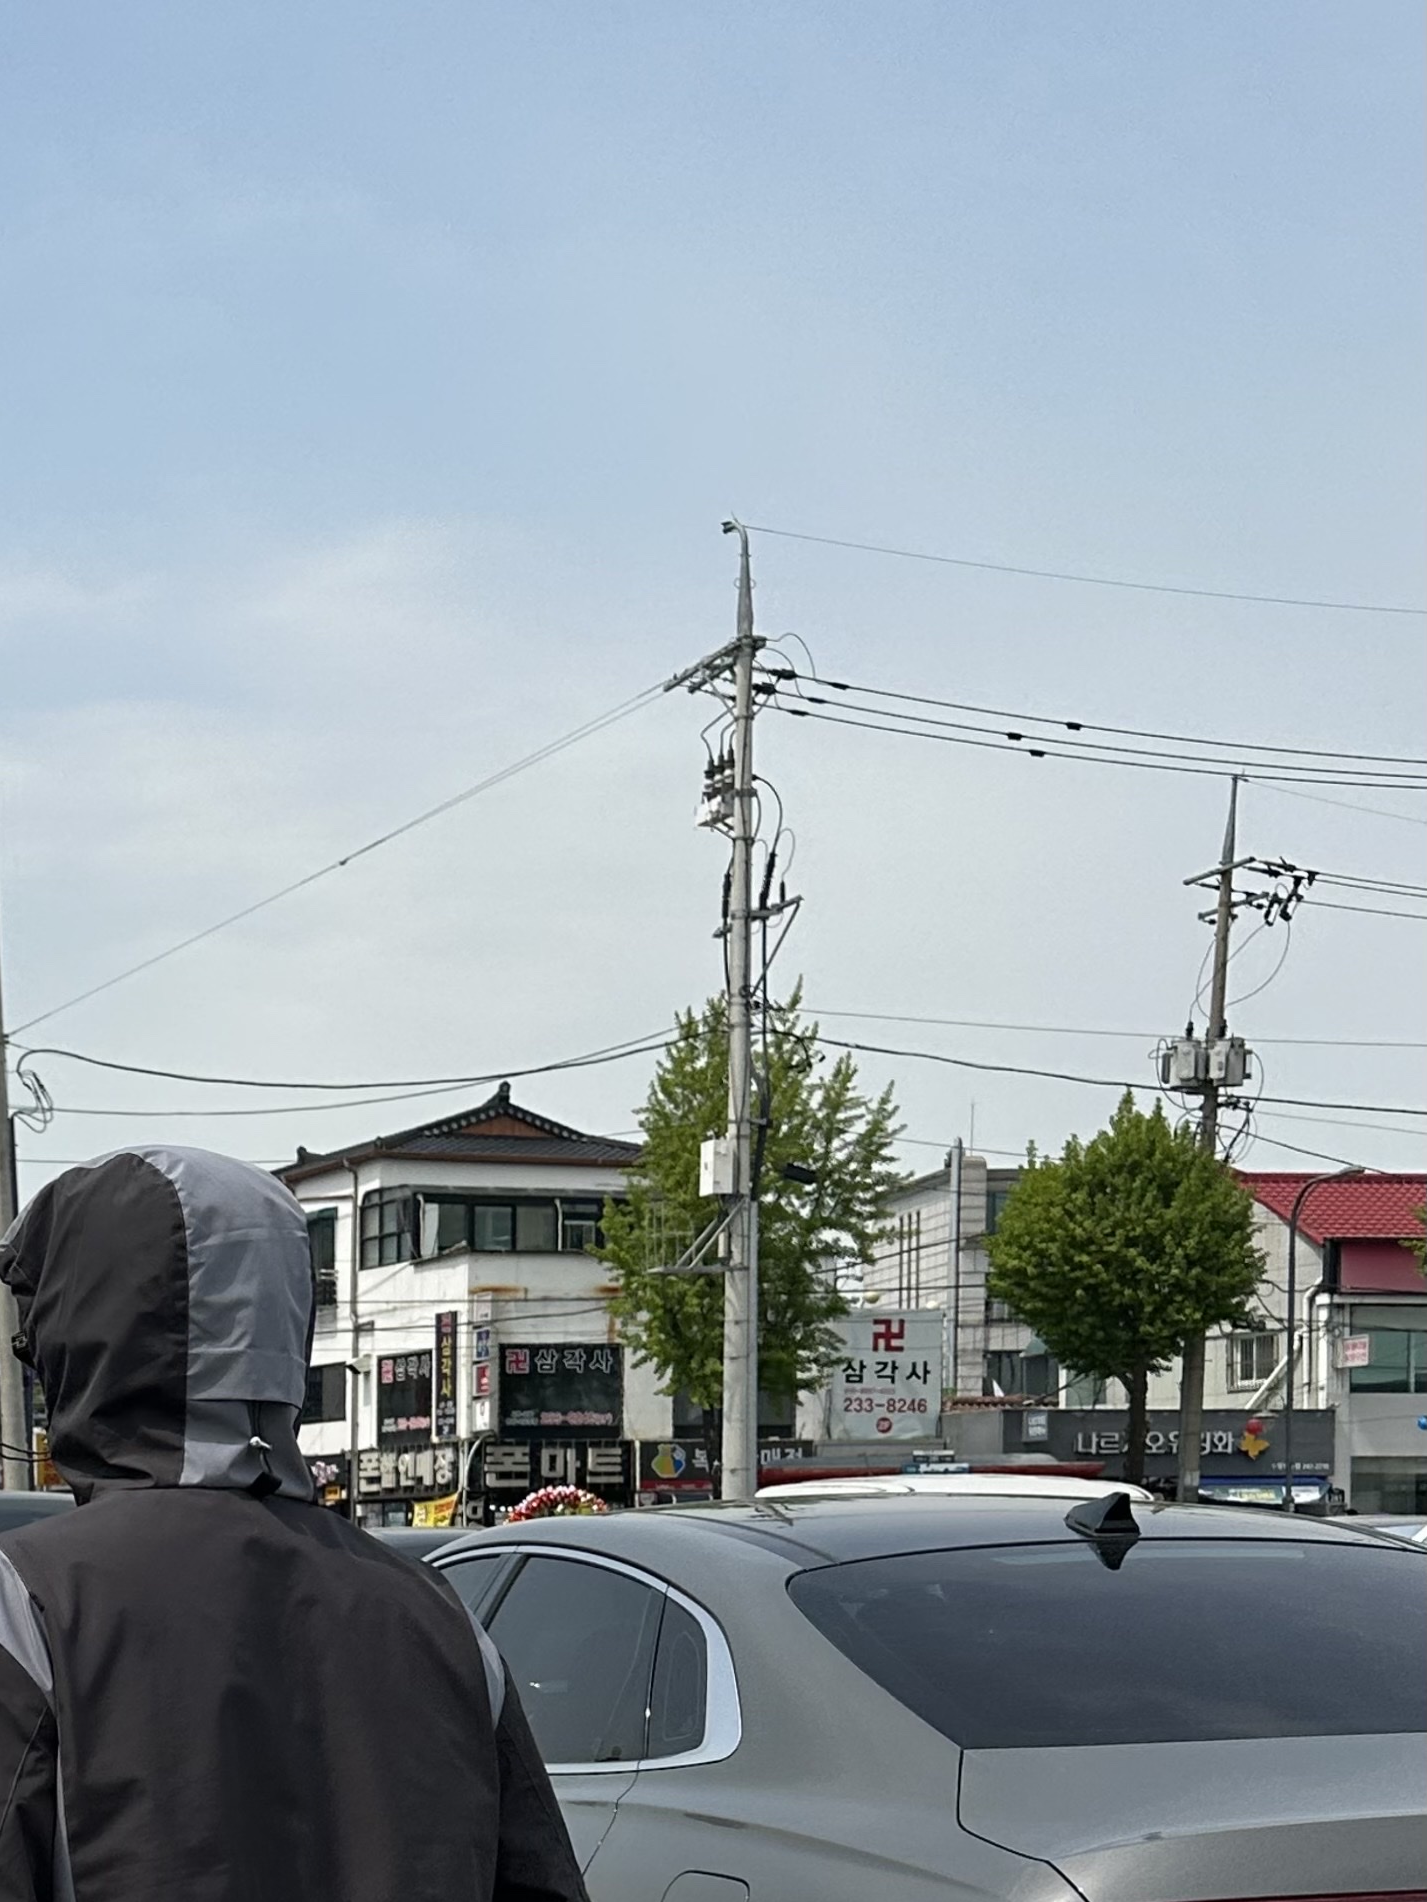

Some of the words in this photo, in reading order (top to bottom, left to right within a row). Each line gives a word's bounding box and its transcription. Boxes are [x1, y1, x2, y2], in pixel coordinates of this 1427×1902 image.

[441, 1335, 452, 1398] 삼각사
[535, 1348, 613, 1373] 삼각사
[842, 1360, 931, 1385] 삼각사
[843, 1398, 928, 1413] 233-8246
[1077, 1431, 1235, 1455] 나르오화
[359, 1449, 455, 1493] 폰할인매장
[484, 1445, 624, 1488] 폰마트
